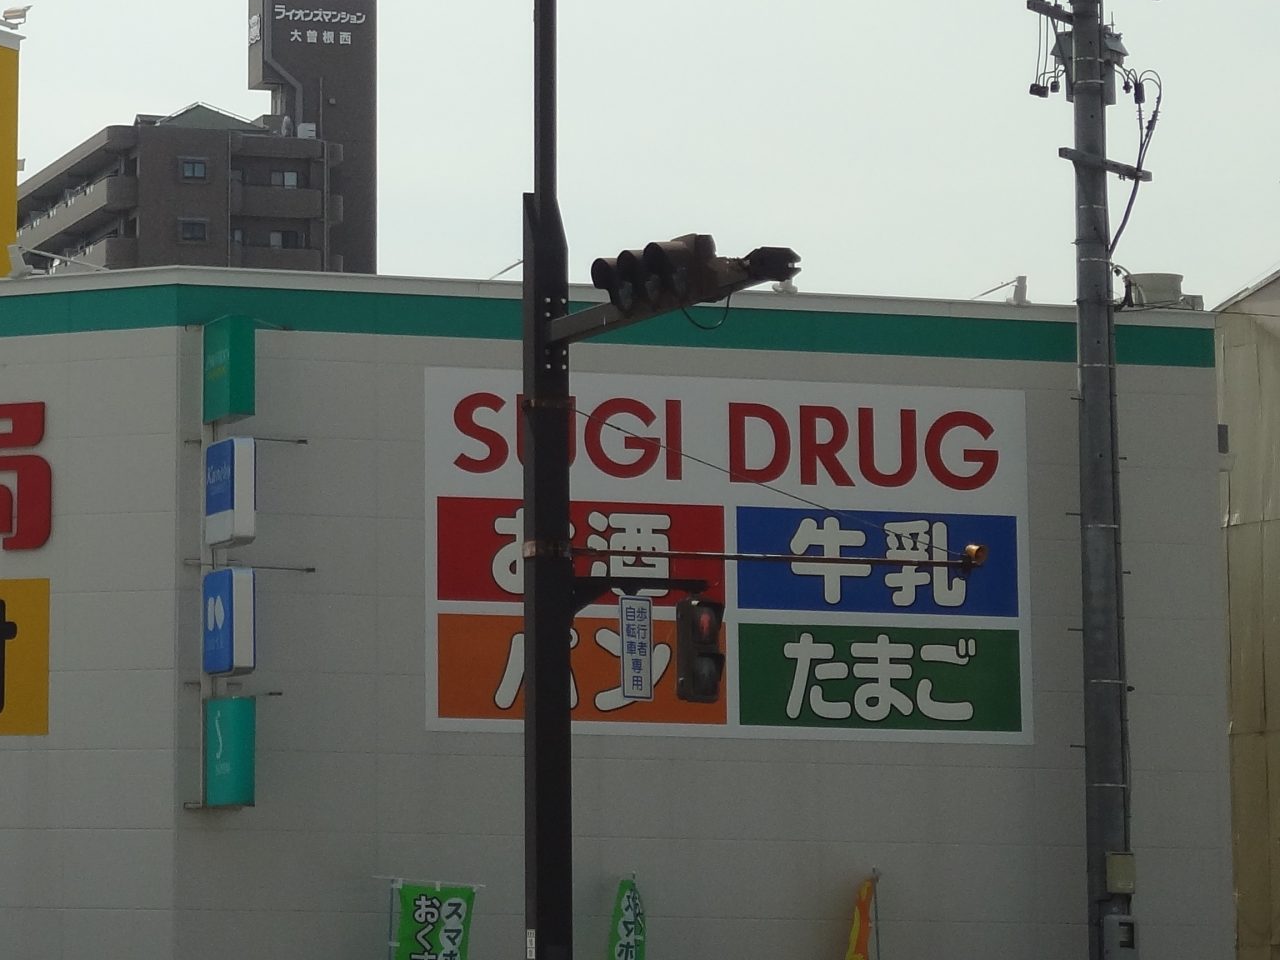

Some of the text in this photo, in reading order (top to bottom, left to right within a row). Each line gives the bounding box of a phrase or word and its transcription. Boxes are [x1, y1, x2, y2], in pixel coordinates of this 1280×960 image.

[274, 5, 366, 24] ライオンズマンション
[728, 402, 1000, 491] DRUG
[789, 515, 967, 607] 牛乳
[784, 632, 977, 724] たまご
[410, 893, 442, 960] おく
